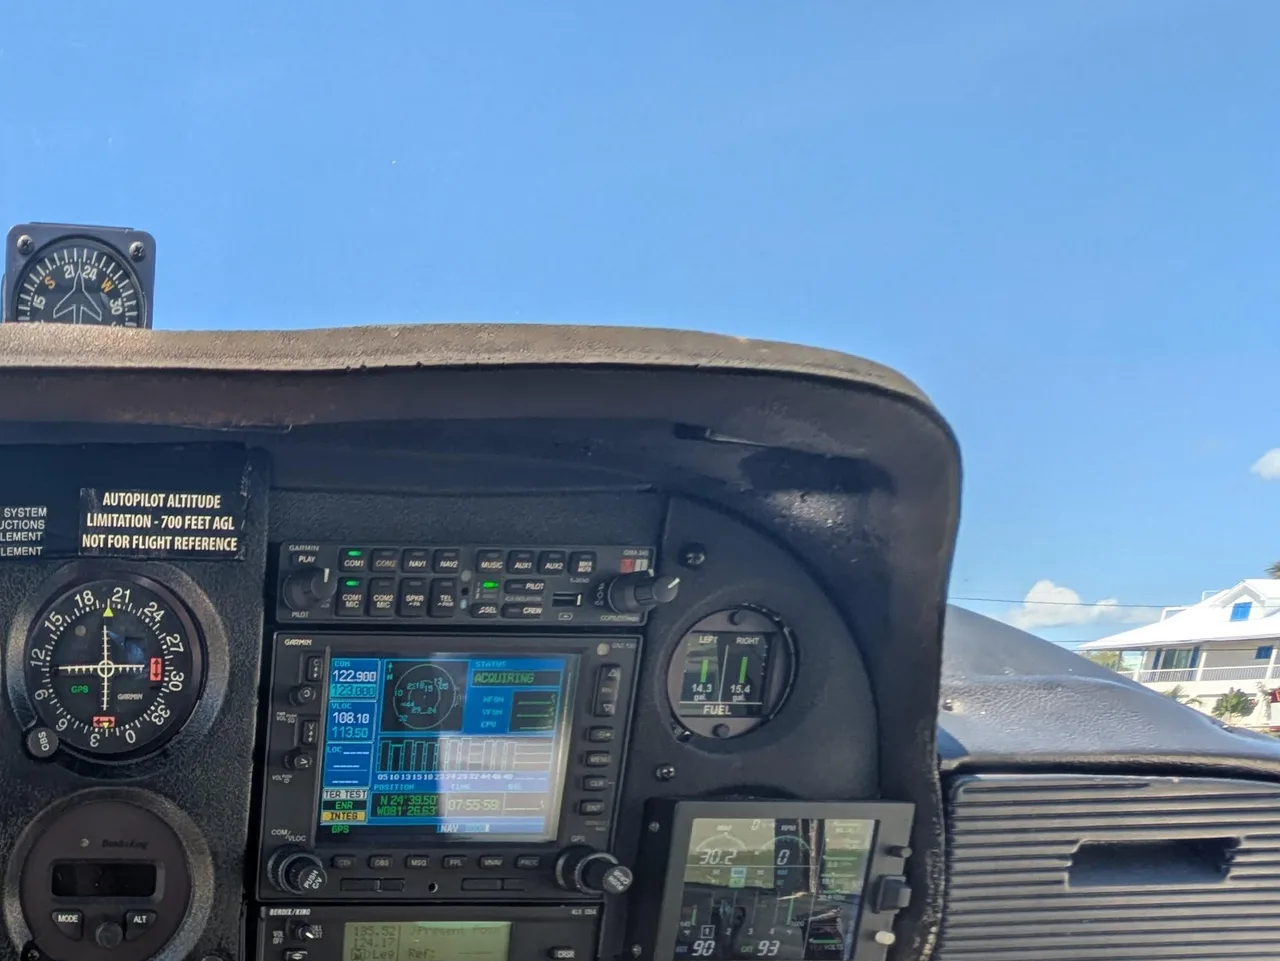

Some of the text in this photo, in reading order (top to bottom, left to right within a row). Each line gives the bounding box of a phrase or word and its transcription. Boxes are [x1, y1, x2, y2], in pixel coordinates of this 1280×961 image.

[101, 278, 115, 293] W
[103, 492, 221, 508] AUTOPILOT ALTITUDE
[4, 507, 47, 517] SYSTEM
[87, 513, 151, 528] LIMITATION
[161, 515, 182, 529] 700
[185, 516, 211, 530] FEET
[213, 517, 235, 530] AGL
[82, 534, 237, 551] NOT FOR FLIGHT REFERENCE
[545, 562, 563, 570] AUX2
[75, 587, 131, 608] 18 21
[166, 633, 184, 653] 27
[699, 636, 718, 644] LEFT
[333, 670, 377, 682] 122.900
[71, 685, 89, 694] GPS
[692, 684, 750, 693] 14.3 15.4
[703, 705, 732, 715] FUEL
[333, 712, 369, 724] 108.10
[332, 727, 368, 738] 113.50
[38, 731, 50, 751] OBS
[345, 790, 367, 799] TEST
[335, 801, 353, 809] ENR
[330, 811, 358, 820] INTEG
[332, 825, 349, 833] GPS
[699, 850, 737, 865] 30.2
[757, 941, 780, 956] 93
